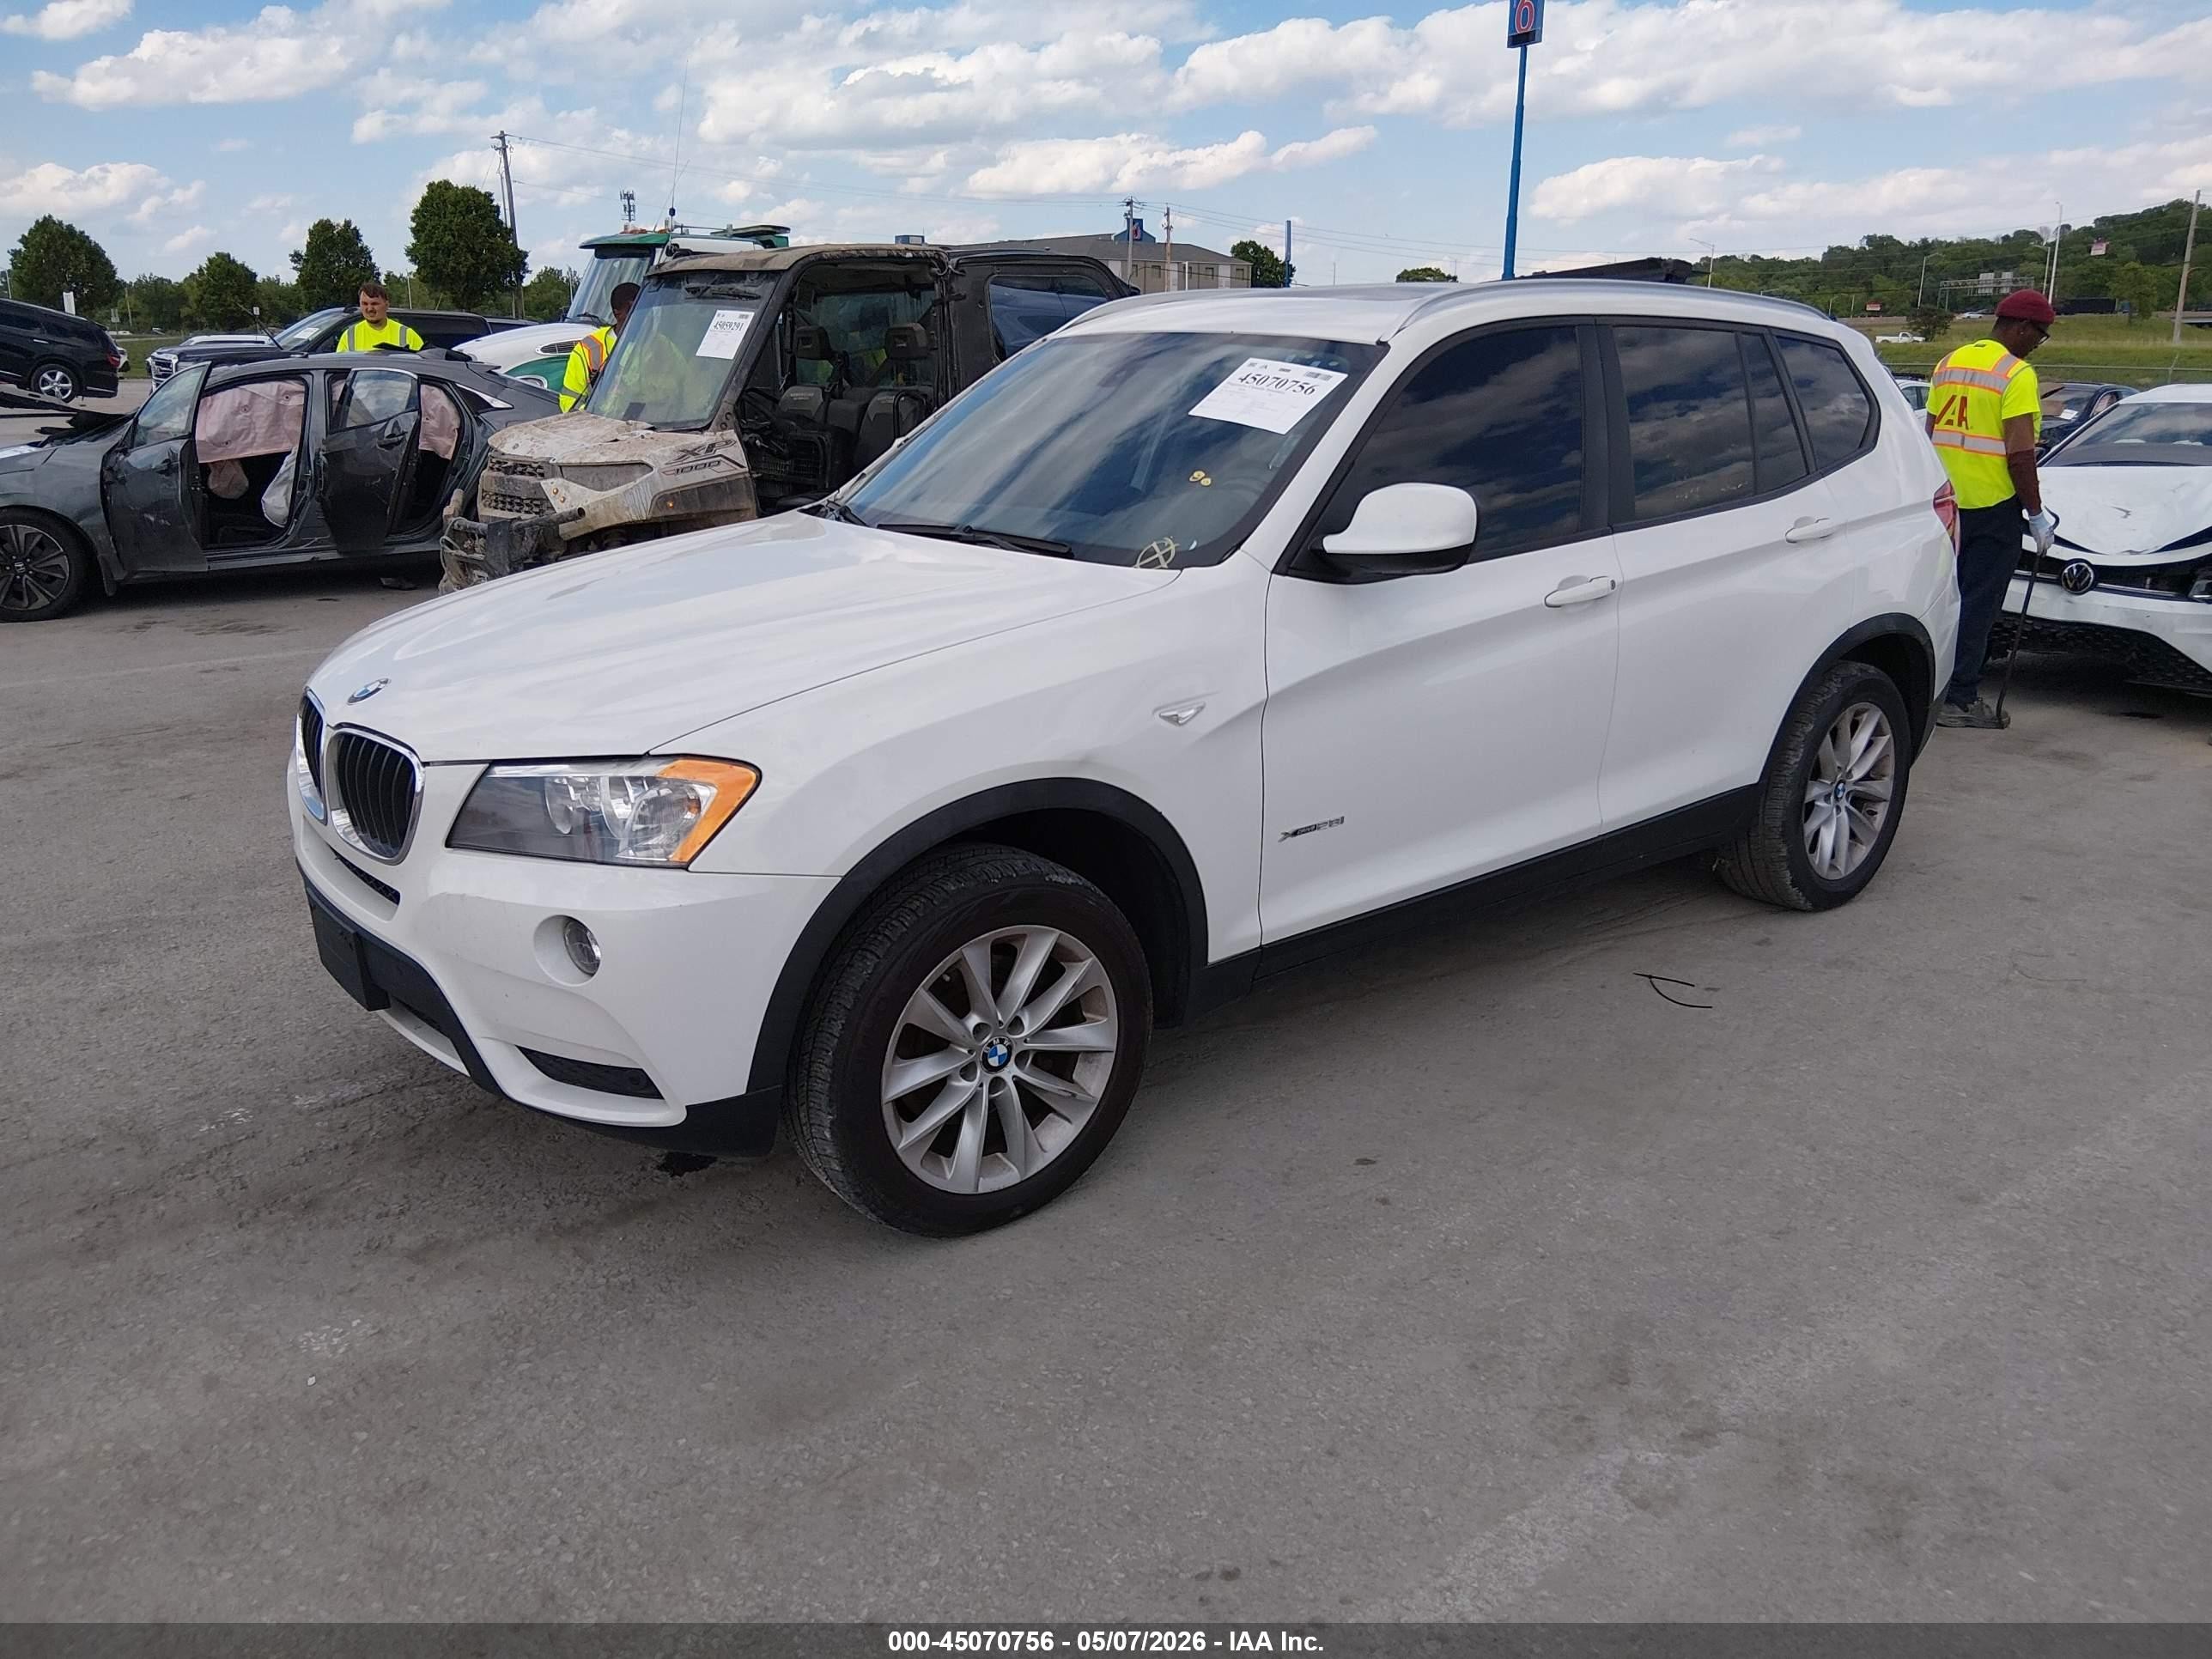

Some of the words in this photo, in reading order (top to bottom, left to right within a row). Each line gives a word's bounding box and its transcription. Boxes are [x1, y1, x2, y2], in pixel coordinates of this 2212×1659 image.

[1237, 372, 1320, 396] 45070756
[666, 438, 738, 465] XP
[675, 459, 722, 476] 1000
[983, 1037, 1012, 1054] BMW
